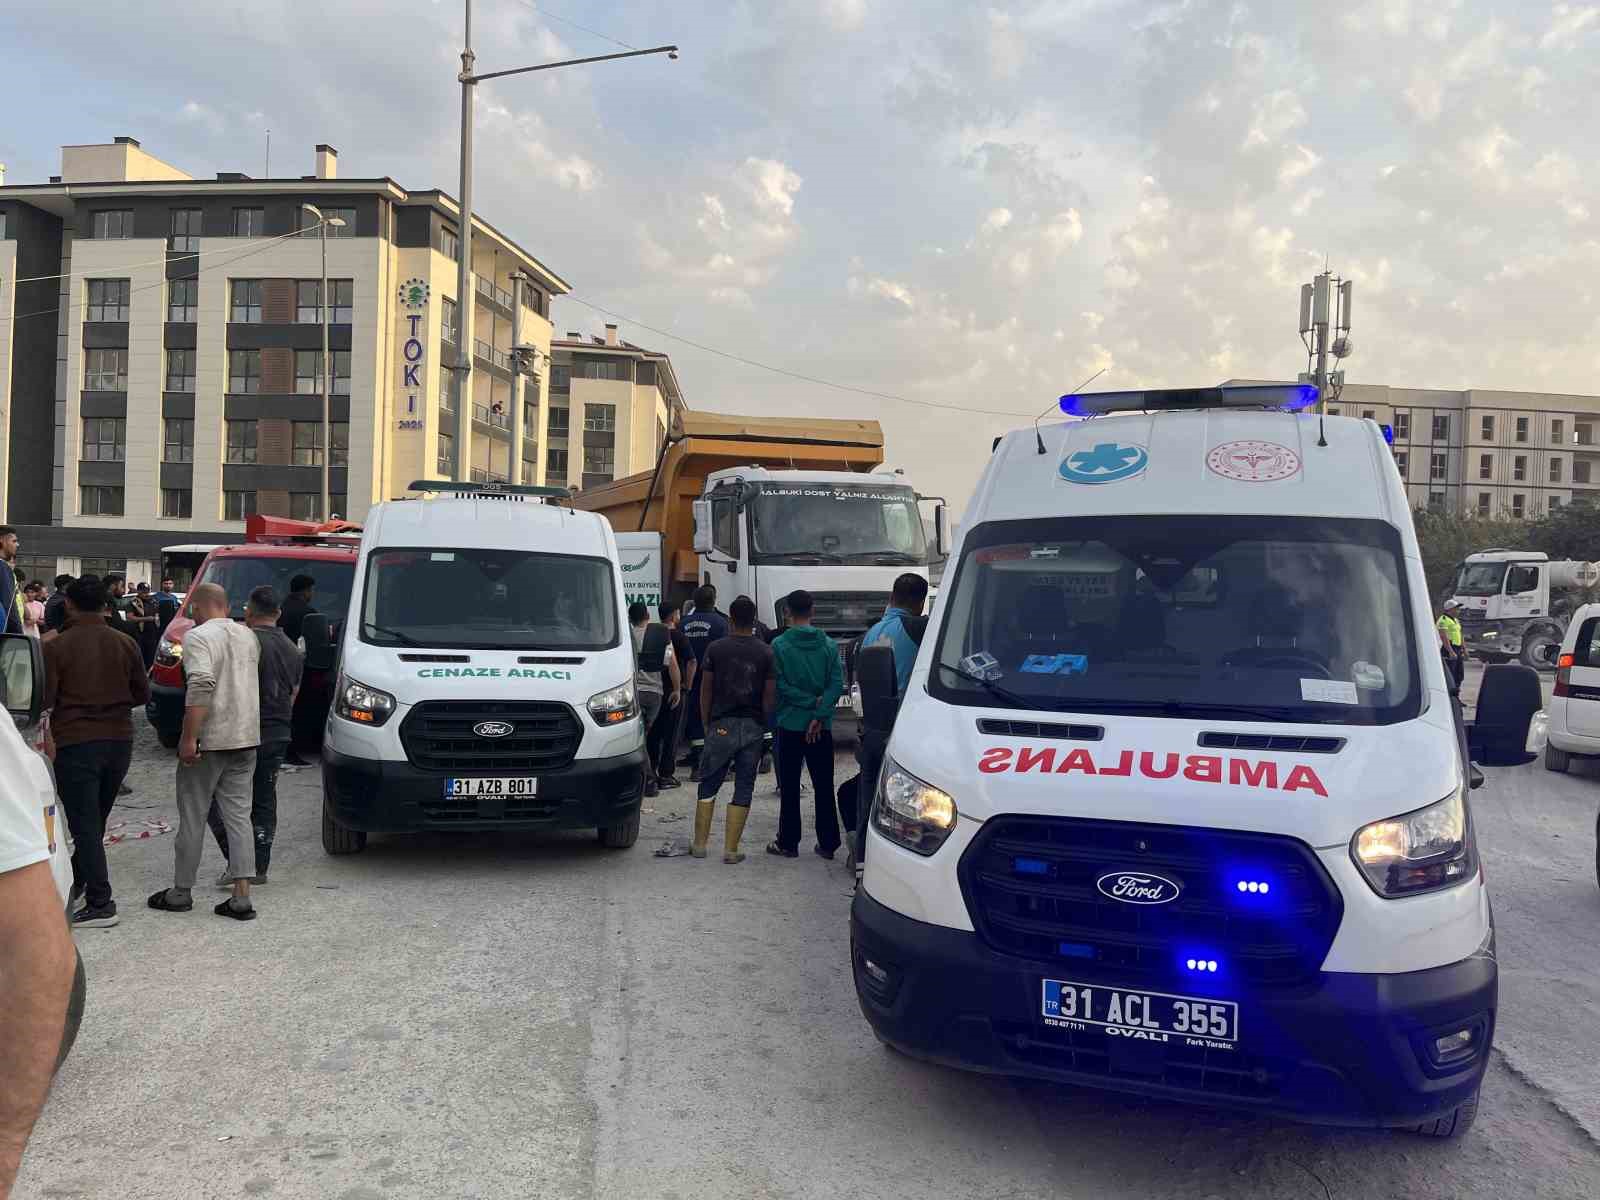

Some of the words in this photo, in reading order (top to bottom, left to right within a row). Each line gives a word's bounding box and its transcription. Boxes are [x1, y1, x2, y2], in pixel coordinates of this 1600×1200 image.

[417, 667, 500, 678] CENAZE
[454, 780, 470, 794] 31
[477, 780, 502, 794] AZB
[508, 780, 532, 793] 801
[1113, 876, 1163, 900] Ford
[1046, 1000, 1059, 1011] TR
[1061, 986, 1092, 1019] 31
[1107, 992, 1160, 1028] ACL
[1172, 1001, 1228, 1037] 355
[1105, 1026, 1169, 1042] OVALI
[1186, 1038, 1204, 1047] Fark
